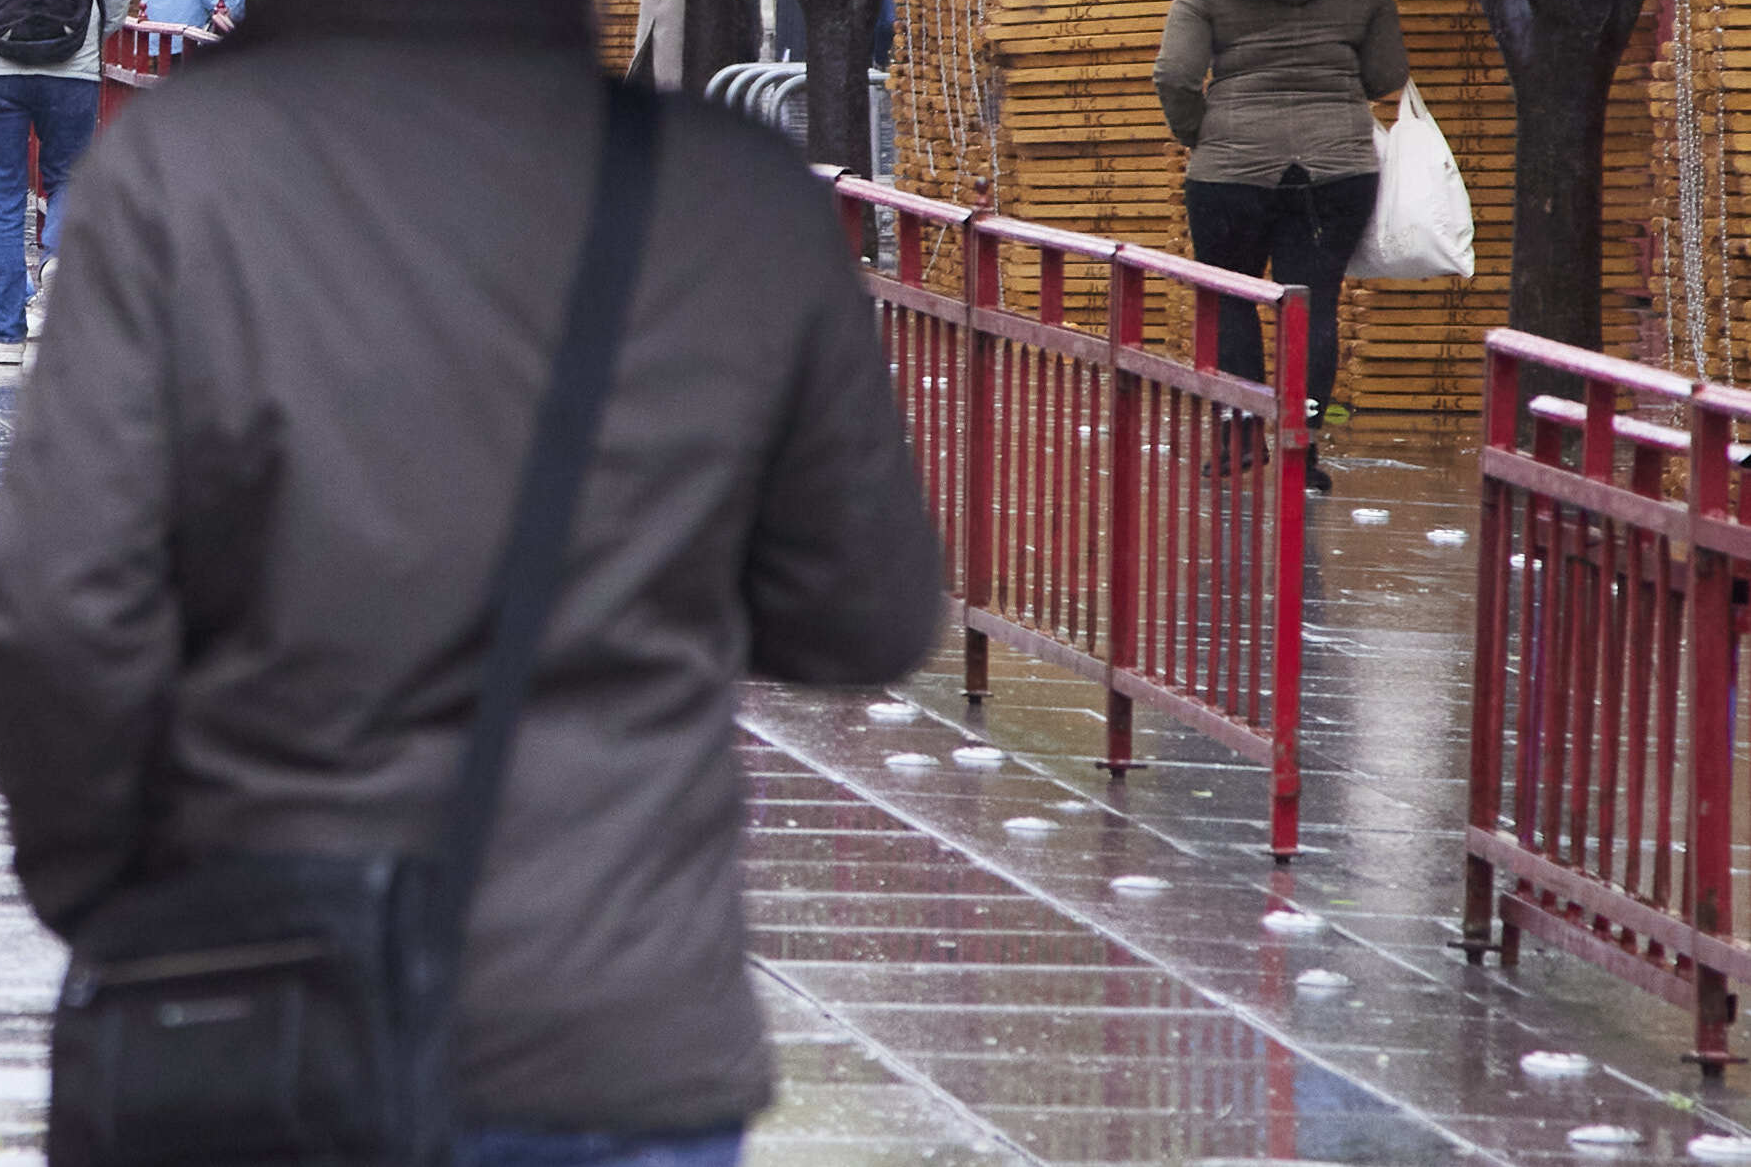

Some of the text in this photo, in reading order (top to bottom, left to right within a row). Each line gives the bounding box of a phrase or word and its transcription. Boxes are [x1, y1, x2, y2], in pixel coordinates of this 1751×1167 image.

[1055, 23, 1081, 35] JLC
[1069, 37, 1093, 49] JLC
[1432, 397, 1462, 409] JLC
